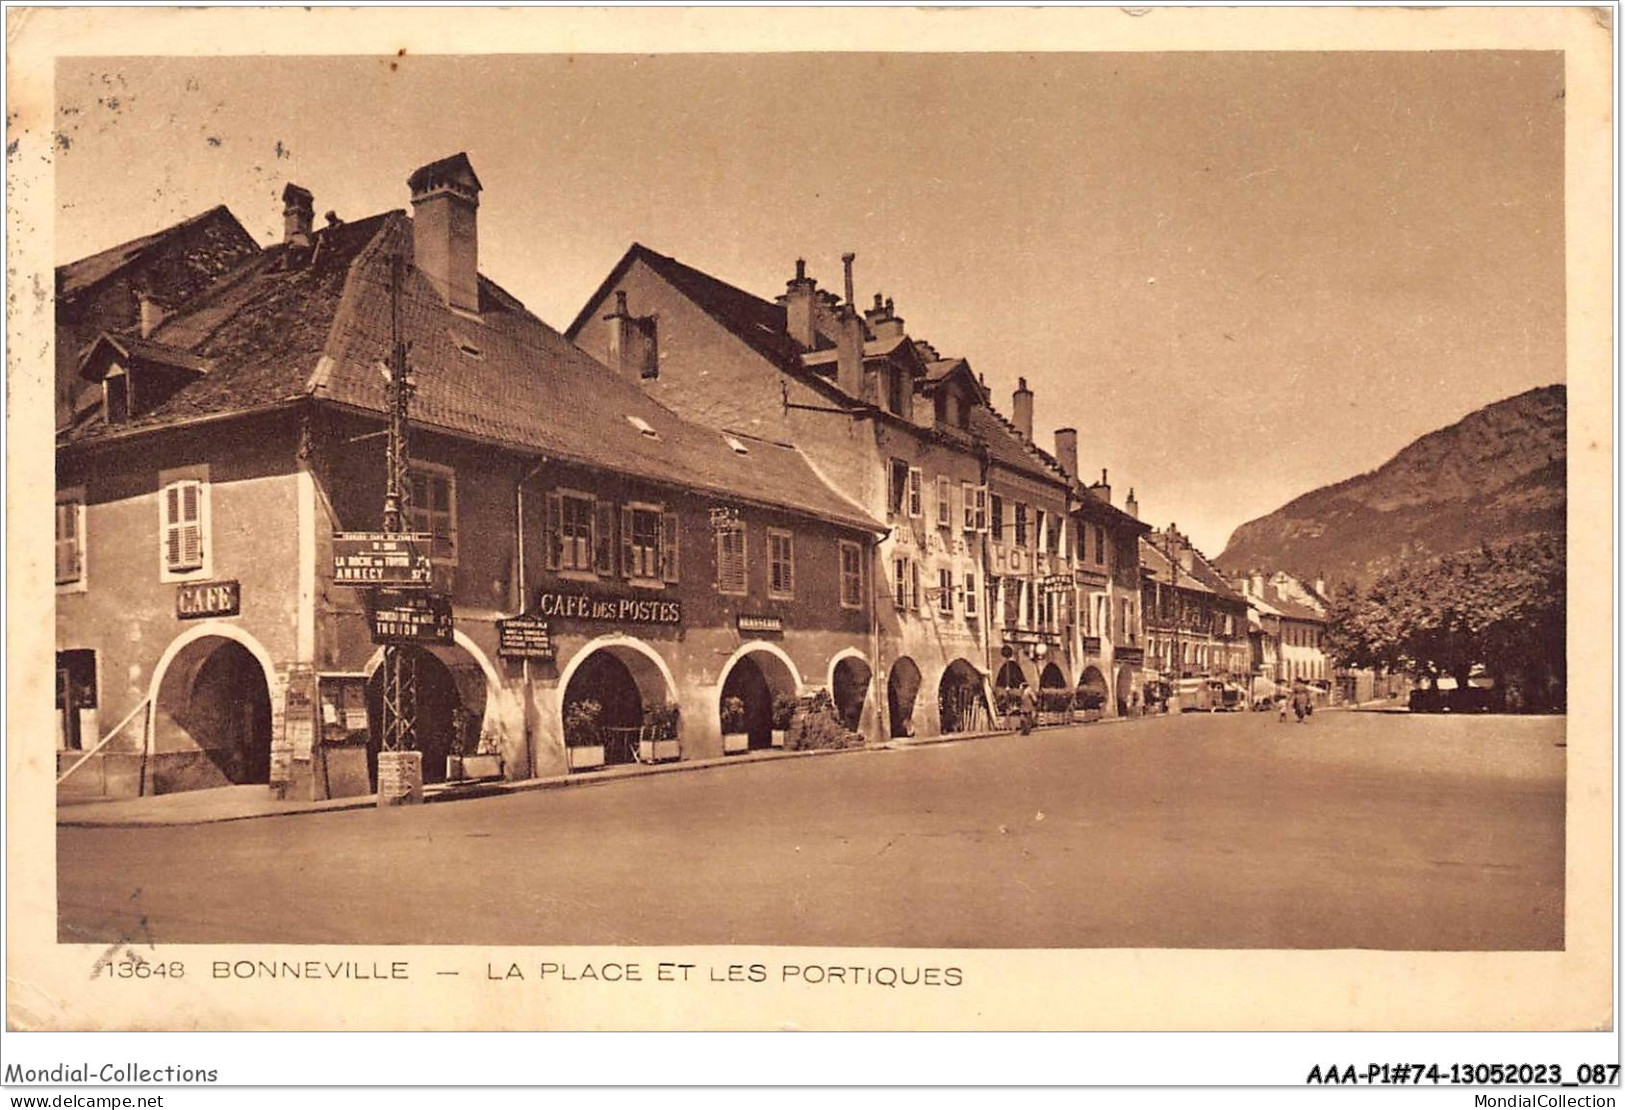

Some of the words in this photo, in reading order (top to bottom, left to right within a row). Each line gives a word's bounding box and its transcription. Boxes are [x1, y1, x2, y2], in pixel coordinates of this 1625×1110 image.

[335, 556, 345, 566] LA
[336, 568, 384, 579] ANNECY
[592, 602, 616, 619] DES
[619, 599, 680, 622] POSTES
